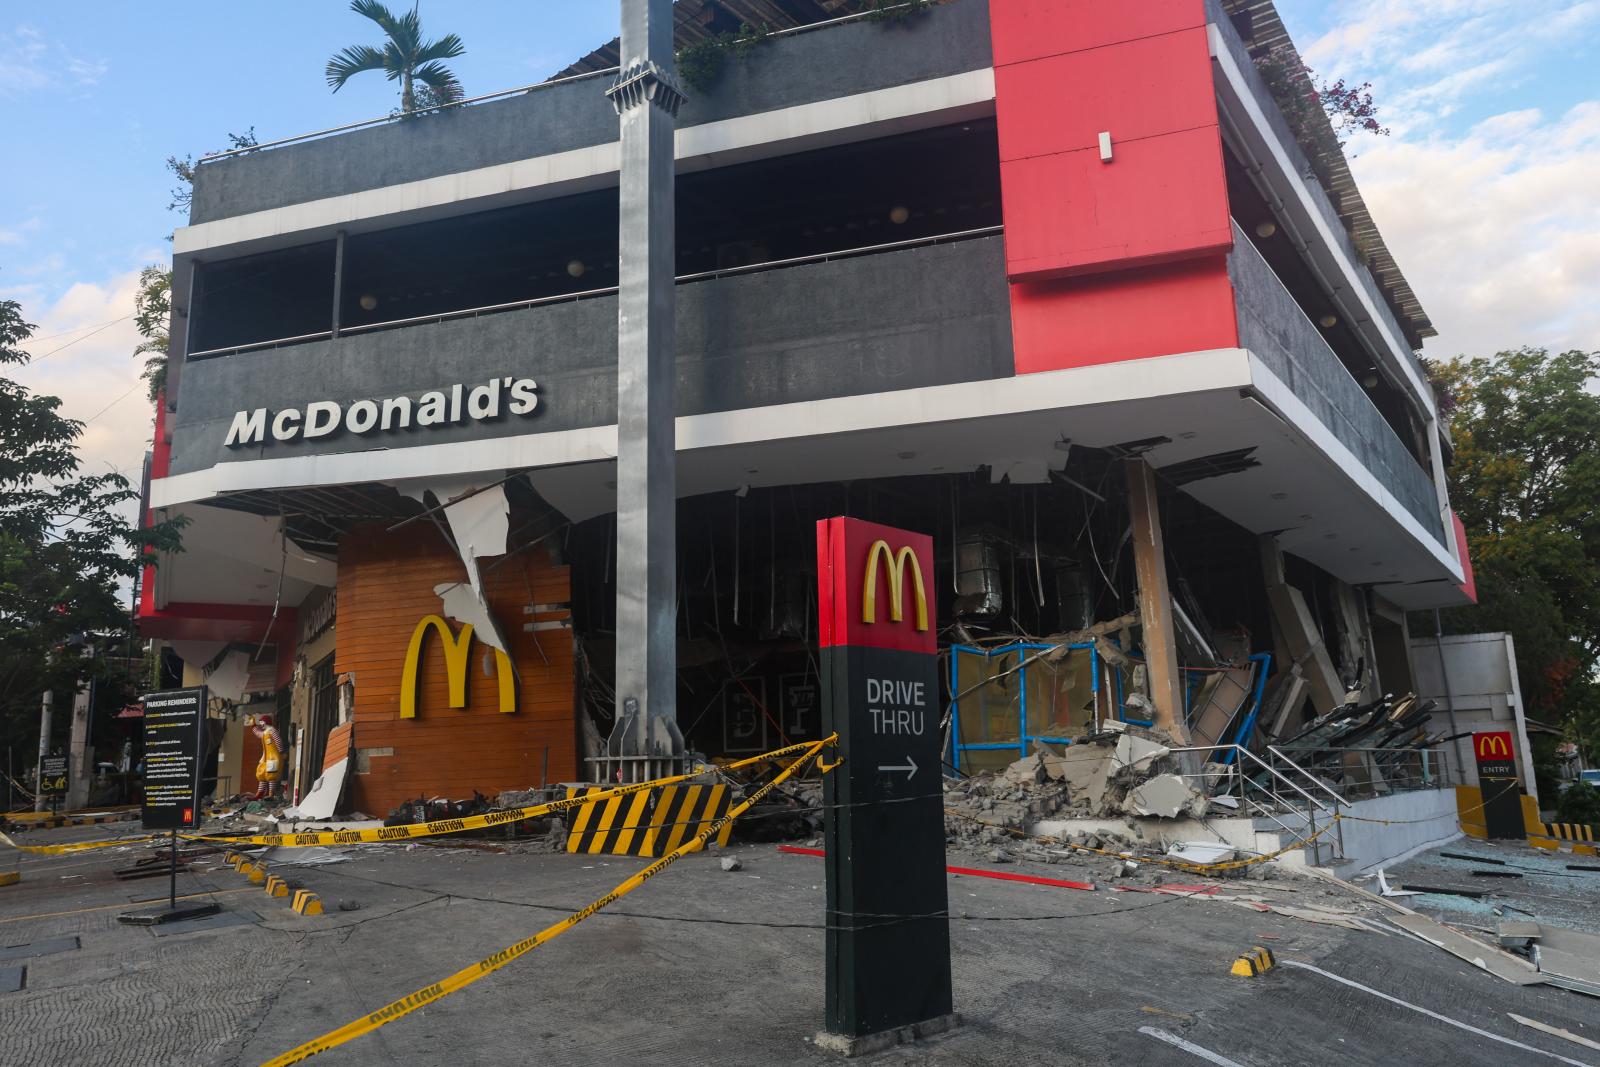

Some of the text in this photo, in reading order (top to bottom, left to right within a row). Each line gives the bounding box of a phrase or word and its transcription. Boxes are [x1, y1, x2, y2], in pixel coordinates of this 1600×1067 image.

[224, 377, 538, 446] McDonald's
[146, 700, 168, 708] PARKING
[867, 678, 926, 706] DRIVE
[869, 708, 924, 736] THRU
[295, 833, 320, 845] CAUTION
[333, 832, 362, 844] CAUTION
[377, 827, 410, 839] CAUTION
[427, 819, 465, 833] CAUTION
[484, 809, 525, 825] CAUTION
